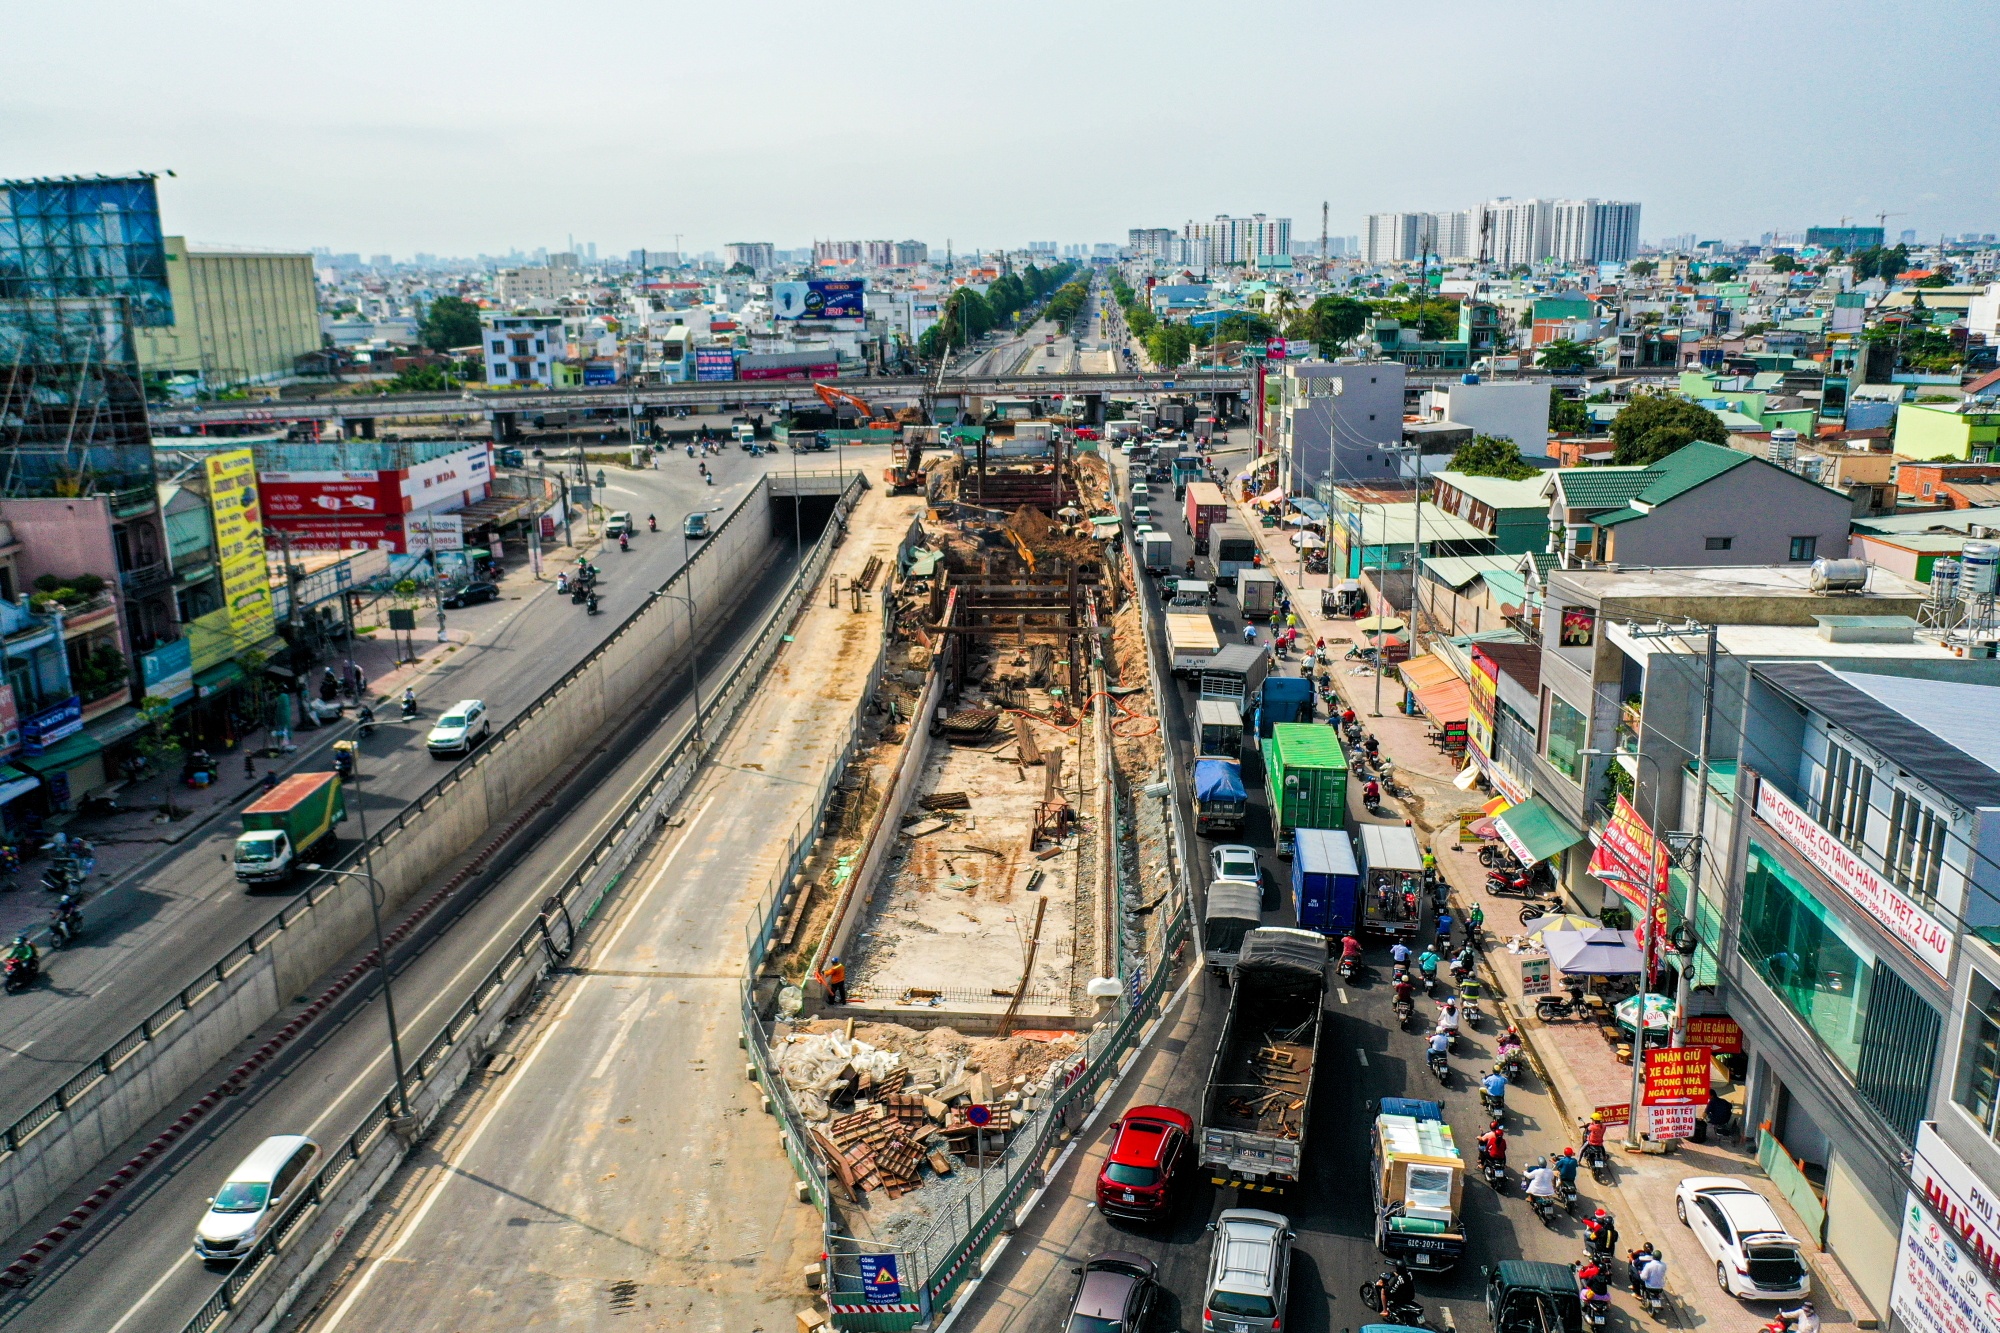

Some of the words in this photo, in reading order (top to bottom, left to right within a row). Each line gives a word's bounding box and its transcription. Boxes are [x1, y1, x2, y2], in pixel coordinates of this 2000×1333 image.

[1777, 801, 1794, 826] CHO
[1818, 833, 1830, 856] CÓ
[1882, 888, 1887, 904] 1
[1914, 918, 1922, 936] 2
[1834, 868, 1850, 889] MINH
[1853, 884, 1868, 906] 0907
[1703, 1023, 1711, 1032] XE
[1712, 1020, 1726, 1033] GẮN
[1726, 1020, 1739, 1034] MÁY
[1654, 1052, 1681, 1064] NHẬN
[1684, 1049, 1701, 1062] GIỮ
[1650, 1067, 1661, 1077] XE
[1664, 1064, 1684, 1076] GẮN
[1686, 1062, 1707, 1074] MÁY
[1654, 1078, 1681, 1087] TRONG
[1683, 1075, 1701, 1085] NHÀ
[1648, 1088, 1672, 1097] NGÀY
[1674, 1086, 1685, 1096] VÀ
[1686, 1087, 1706, 1095] ĐÊM
[1616, 1107, 1629, 1115] XE
[1666, 1107, 1678, 1115] BÍT
[1679, 1106, 1694, 1115] TẾT
[1666, 1116, 1680, 1124] XÀO
[1970, 1186, 1992, 1223] PHỤ
[1924, 1175, 2000, 1278] HUỲN
[1941, 1255, 1954, 1274] FAW
[1957, 1275, 1982, 1308] ISUZU
[1915, 1296, 1934, 1324] NHẬN
[1949, 1284, 1959, 1304] CÁC
[1973, 1314, 1981, 1332] XE
